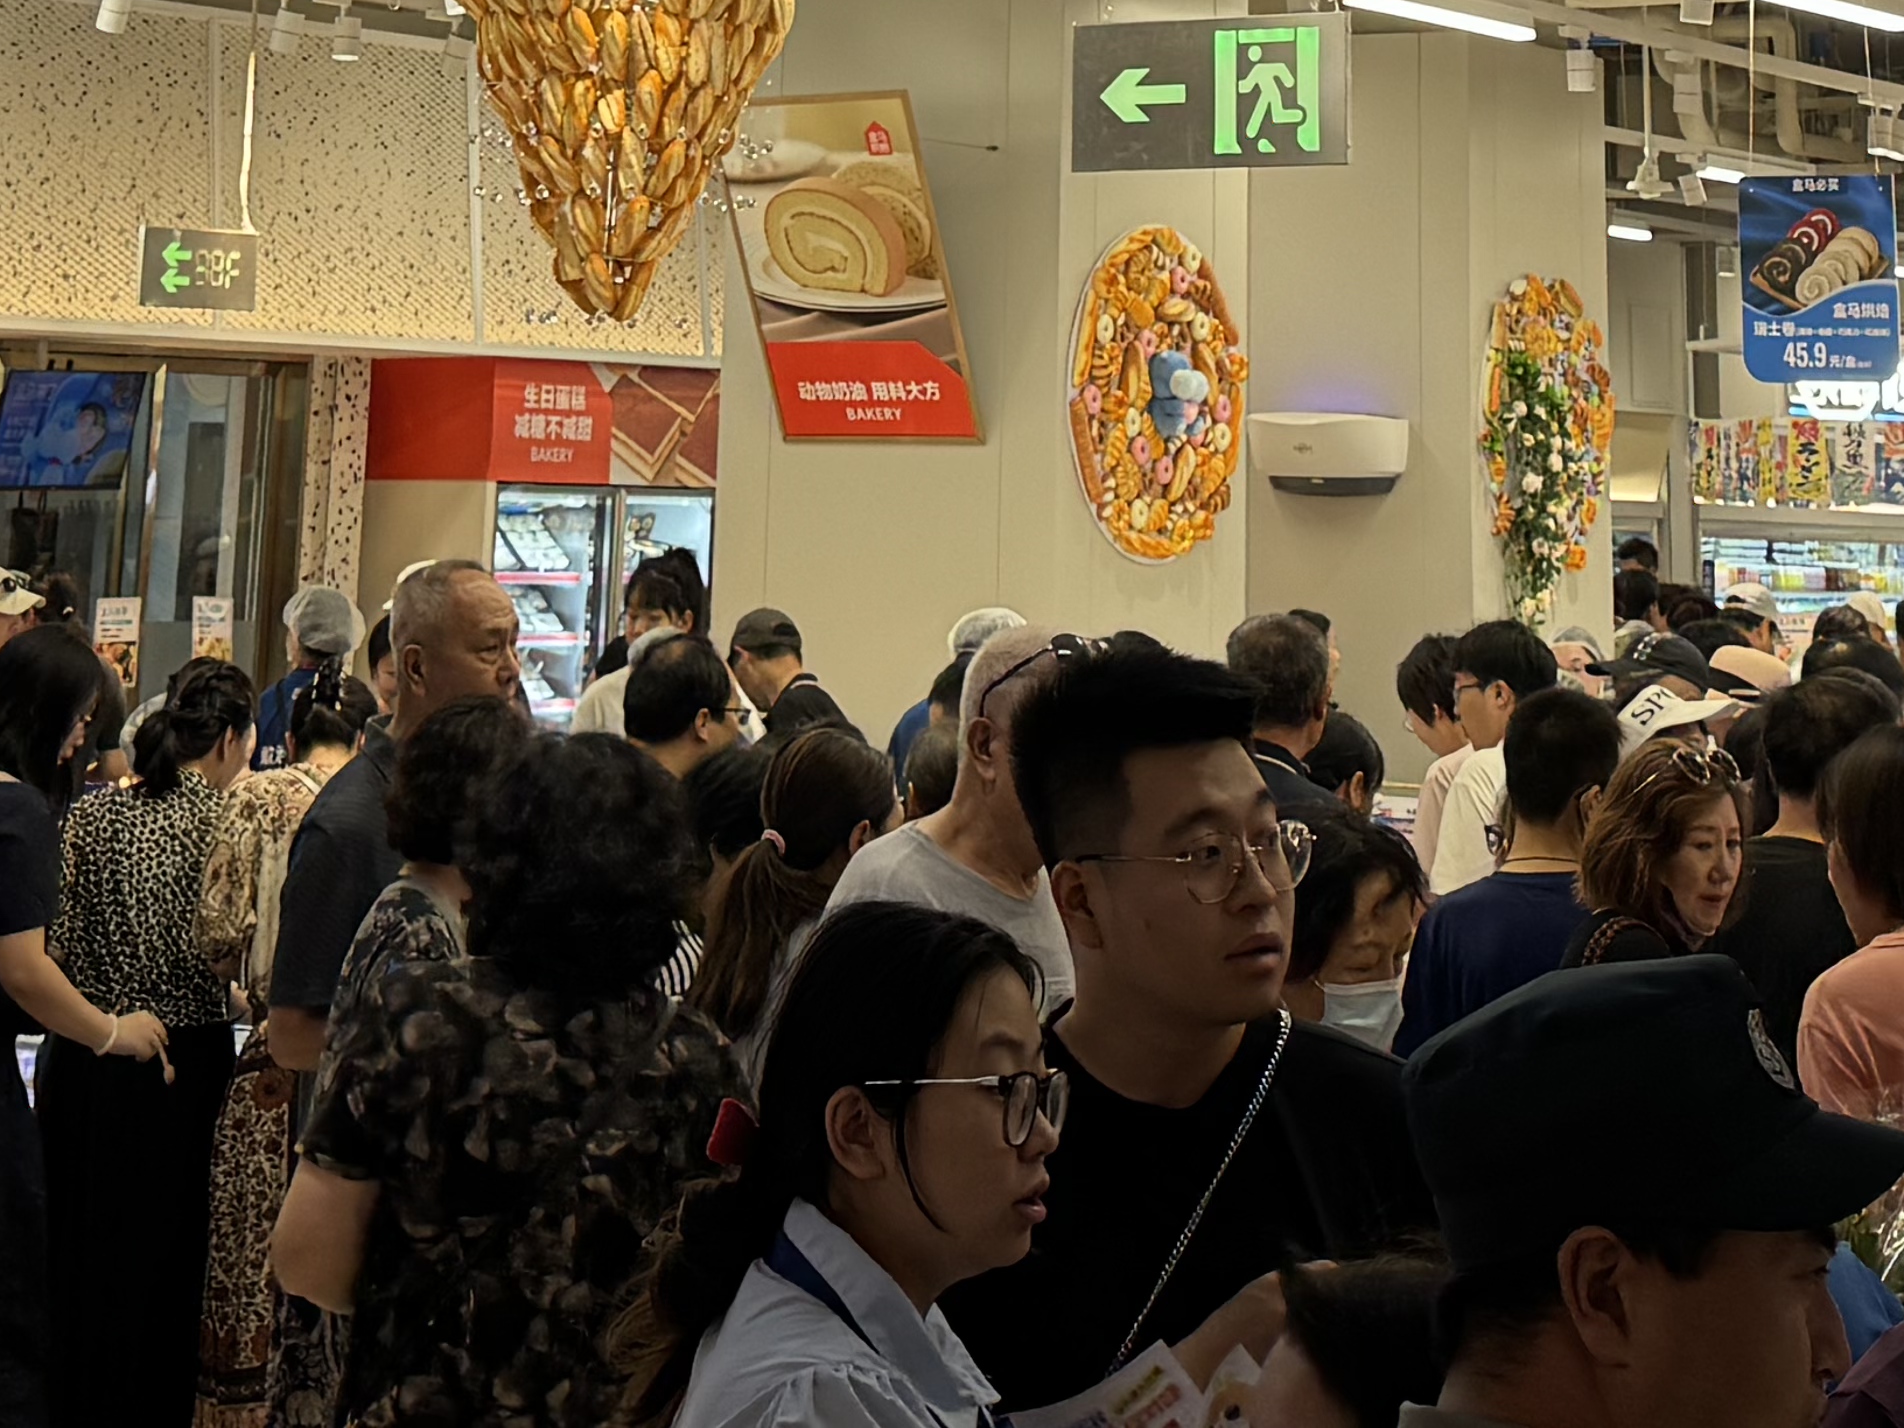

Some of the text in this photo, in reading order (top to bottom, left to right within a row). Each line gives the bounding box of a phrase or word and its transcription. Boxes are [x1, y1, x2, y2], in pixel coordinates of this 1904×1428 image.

[1792, 178, 1840, 192] 盒马必买
[1833, 302, 1891, 319] 盒马烘焙
[1783, 342, 1827, 369] 45.9
[524, 382, 587, 412] 生日蛋糕
[797, 380, 941, 402] 动物奶油 用料大方
[846, 407, 902, 422] BAKERY
[514, 413, 593, 441] 减糖不减甜
[530, 446, 574, 463] BAKERY
